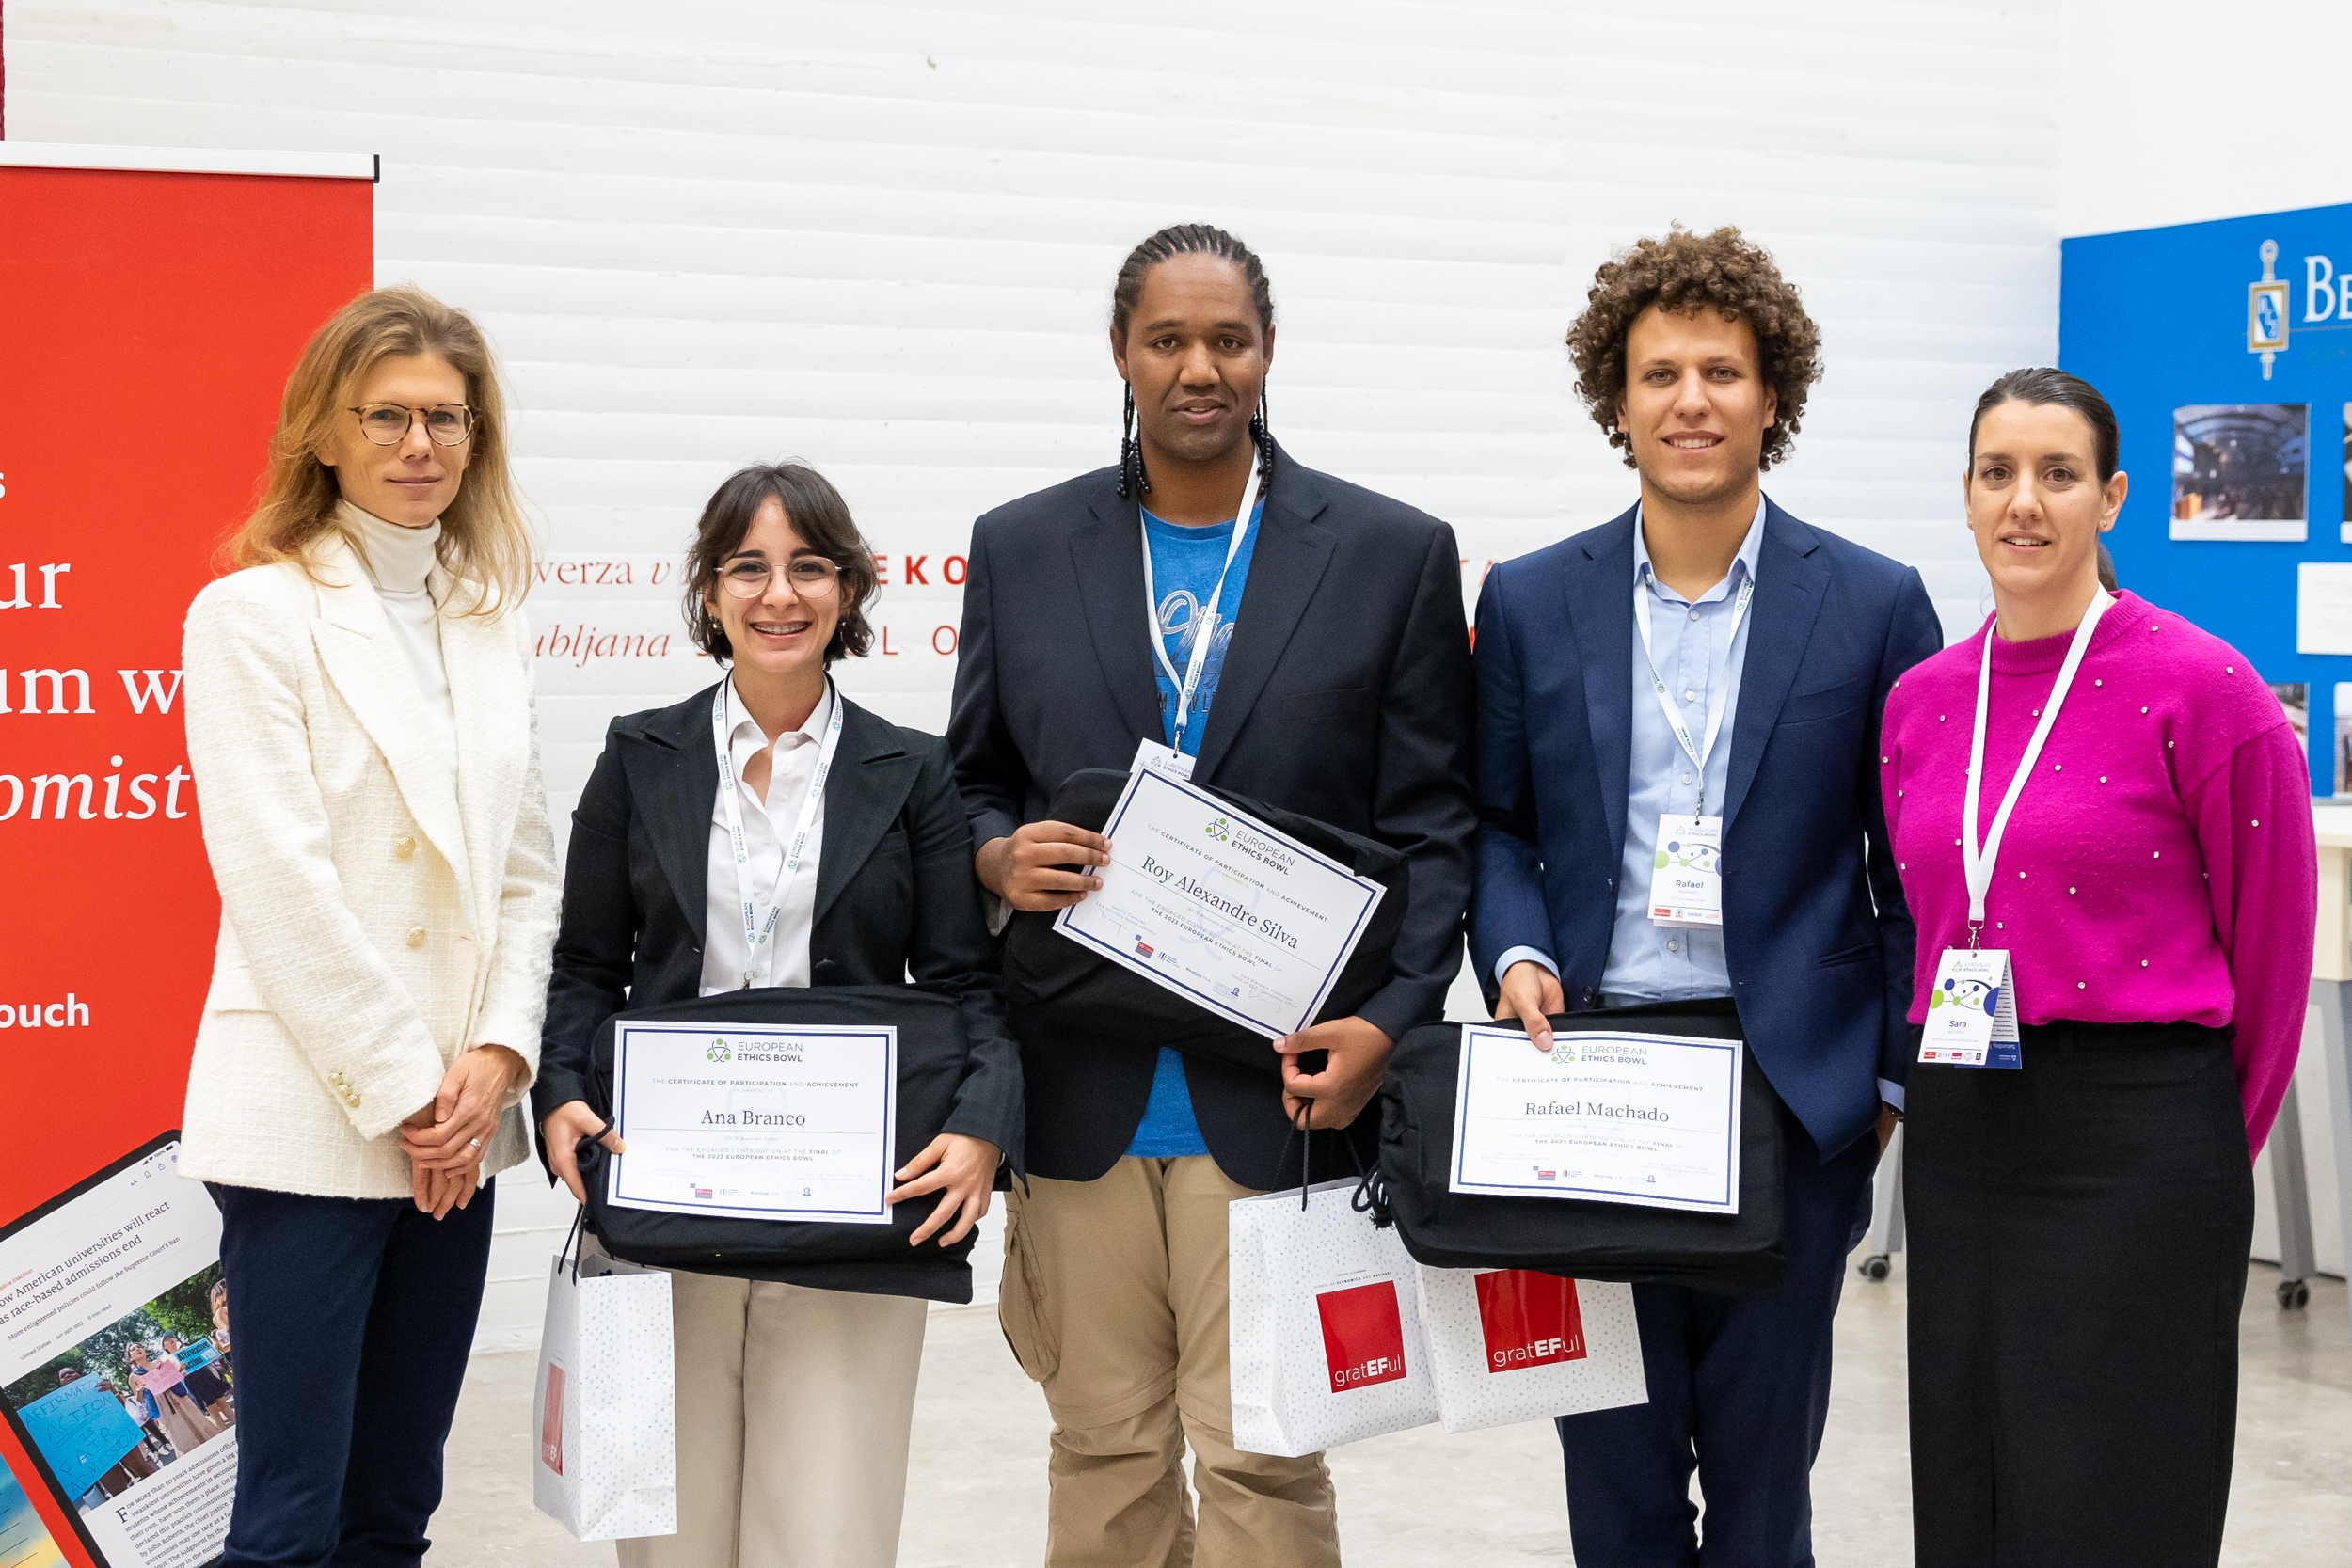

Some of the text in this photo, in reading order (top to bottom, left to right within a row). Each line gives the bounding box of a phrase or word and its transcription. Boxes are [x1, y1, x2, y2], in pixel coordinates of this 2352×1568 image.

[1231, 840, 1288, 875] ETHICS BOWL
[1235, 831, 1295, 865] EUROPEAN
[1148, 824, 1158, 832] THE
[1160, 832, 1201, 856] CERTIFICATE
[1214, 860, 1264, 888] PARTICIPATION
[1266, 887, 1279, 896] AND
[1280, 895, 1327, 921] ACHIEVEMENT
[1676, 880, 1704, 889] Rafael
[1141, 855, 1173, 883] Roy
[1174, 876, 1257, 926] Alexandre
[1259, 919, 1297, 949] Silva
[1130, 889, 1142, 897] FOR
[1144, 896, 1155, 906] THE
[1156, 903, 1185, 921] ENGAGED
[1186, 919, 1231, 945] CONTRIBUTION
[1242, 948, 1252, 957] THE
[1254, 955, 1272, 968] FINAL
[1151, 907, 1255, 966] THE 2023 EUROPEAN ETHICS BOWL
[1949, 1020, 1967, 1028] Sara
[738, 1041, 803, 1052] EUROPEAN
[773, 1053, 802, 1062] BOWL
[1581, 1045, 1646, 1055] EUROPEAN
[1617, 1056, 1646, 1065] BOWL
[701, 1110, 804, 1125] Ana Branco
[1525, 1101, 1668, 1121] Rafael Machado
[4, 1265, 64, 1302] American
[64, 1229, 123, 1267] universities
[123, 1215, 144, 1231] will
[144, 1201, 169, 1220] react
[8, 1329, 24, 1340] More
[24, 1308, 57, 1331] enlightened
[56, 1296, 79, 1312] policies
[79, 1285, 96, 1298] could
[95, 1275, 113, 1289] follow
[123, 1255, 149, 1272] Supreme
[149, 1243, 168, 1257] Court's
[167, 1236, 180, 1245] ban
[10, 1280, 63, 1317] race-based
[64, 1247, 121, 1285] admissions
[122, 1234, 142, 1251] end
[12, 1268, 33, 1282] inaction
[1334, 1354, 1402, 1386] gratEFul
[1493, 1335, 1580, 1367] gratEFul
[24, 1379, 100, 1427] AFFIRMATIV
[47, 1394, 112, 1441] ACTION
[59, 1426, 115, 1476] FAIR
[79, 1426, 96, 1441] IS
[70, 1428, 137, 1497] ADMISSION
[135, 1491, 151, 1503] MORE
[151, 1483, 165, 1494] than
[172, 1469, 187, 1481] years
[187, 1449, 219, 1471] admissions
[125, 1515, 149, 1532] students
[149, 1504, 167, 1516] whose
[167, 1481, 206, 1506] achievements
[213, 1461, 240, 1480] secondar
[131, 1497, 159, 1516] swankiest
[159, 1478, 192, 1499] universities
[191, 1469, 205, 1481] have
[205, 1460, 222, 1473] given
[129, 1529, 143, 1540] their
[144, 1522, 158, 1531] own,
[158, 1513, 172, 1523] have
[171, 1505, 185, 1514] won
[184, 1496, 200, 1507] them
[204, 1483, 221, 1497] place.
[135, 1531, 159, 1548] declared
[158, 1525, 170, 1534] this
[170, 1512, 193, 1528] practice
[147, 1542, 162, 1553] John
[161, 1528, 184, 1544] Roberts,
[184, 1522, 194, 1530] the
[194, 1512, 209, 1524] chief
[208, 1499, 230, 1517] justice,
[145, 1544, 178, 1565] universities
[178, 1535, 190, 1545] may
[190, 1529, 201, 1538] use
[200, 1522, 213, 1531] race
[167, 1553, 180, 1561] The
[179, 1537, 207, 1557] judgment
[192, 1551, 201, 1560] the
[202, 1538, 226, 1554] number
